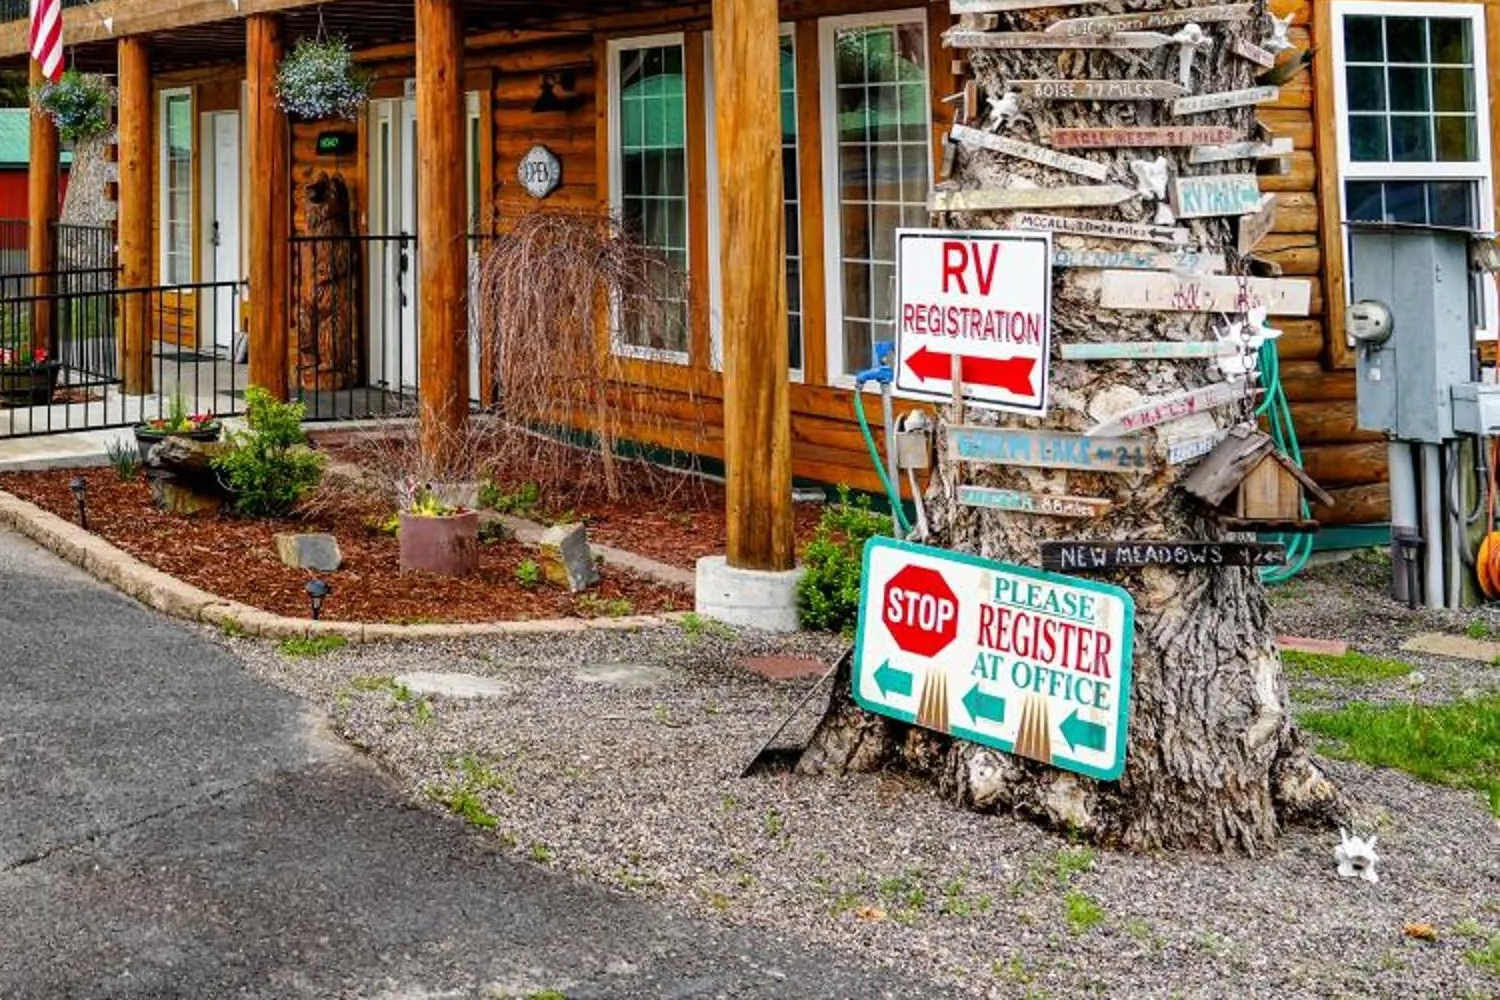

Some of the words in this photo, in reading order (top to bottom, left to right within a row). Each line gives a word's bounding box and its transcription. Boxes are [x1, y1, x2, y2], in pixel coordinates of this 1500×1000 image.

[1034, 83, 1076, 98] BOISE
[524, 161, 550, 184] OPEN
[942, 241, 1000, 297] RV
[902, 303, 1042, 346] REGISTRATION
[1060, 547, 1108, 568] NEW
[1115, 545, 1224, 566] MEADOWS
[886, 586, 956, 634] STOP
[993, 576, 1096, 621] PLEASE
[977, 603, 1112, 679] REGISTER
[970, 651, 1005, 682] AT
[1011, 660, 1112, 712] OFFICE
